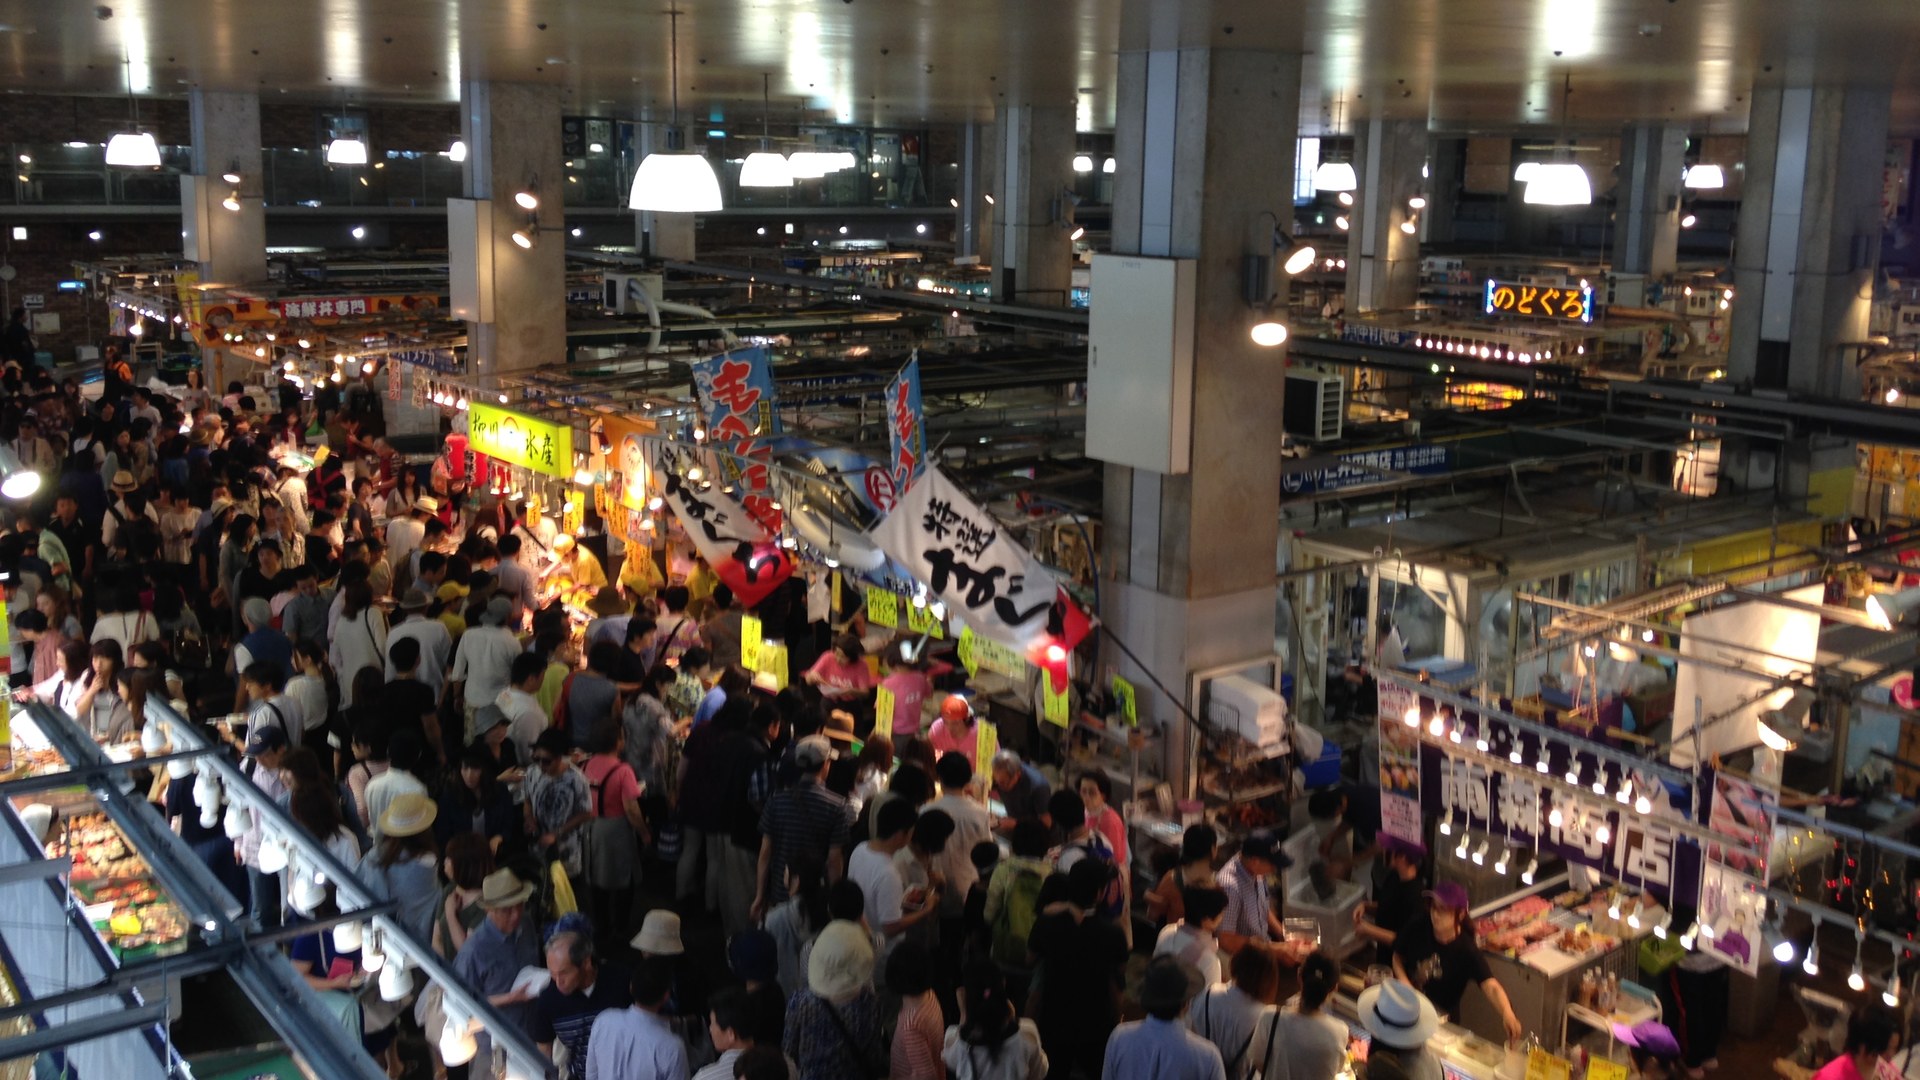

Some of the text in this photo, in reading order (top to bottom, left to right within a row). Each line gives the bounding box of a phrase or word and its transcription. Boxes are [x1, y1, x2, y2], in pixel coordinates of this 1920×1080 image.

[284, 299, 366, 318] 海鮮丼専門
[1493, 286, 1583, 318] のどぐろ
[922, 497, 996, 563] 特選
